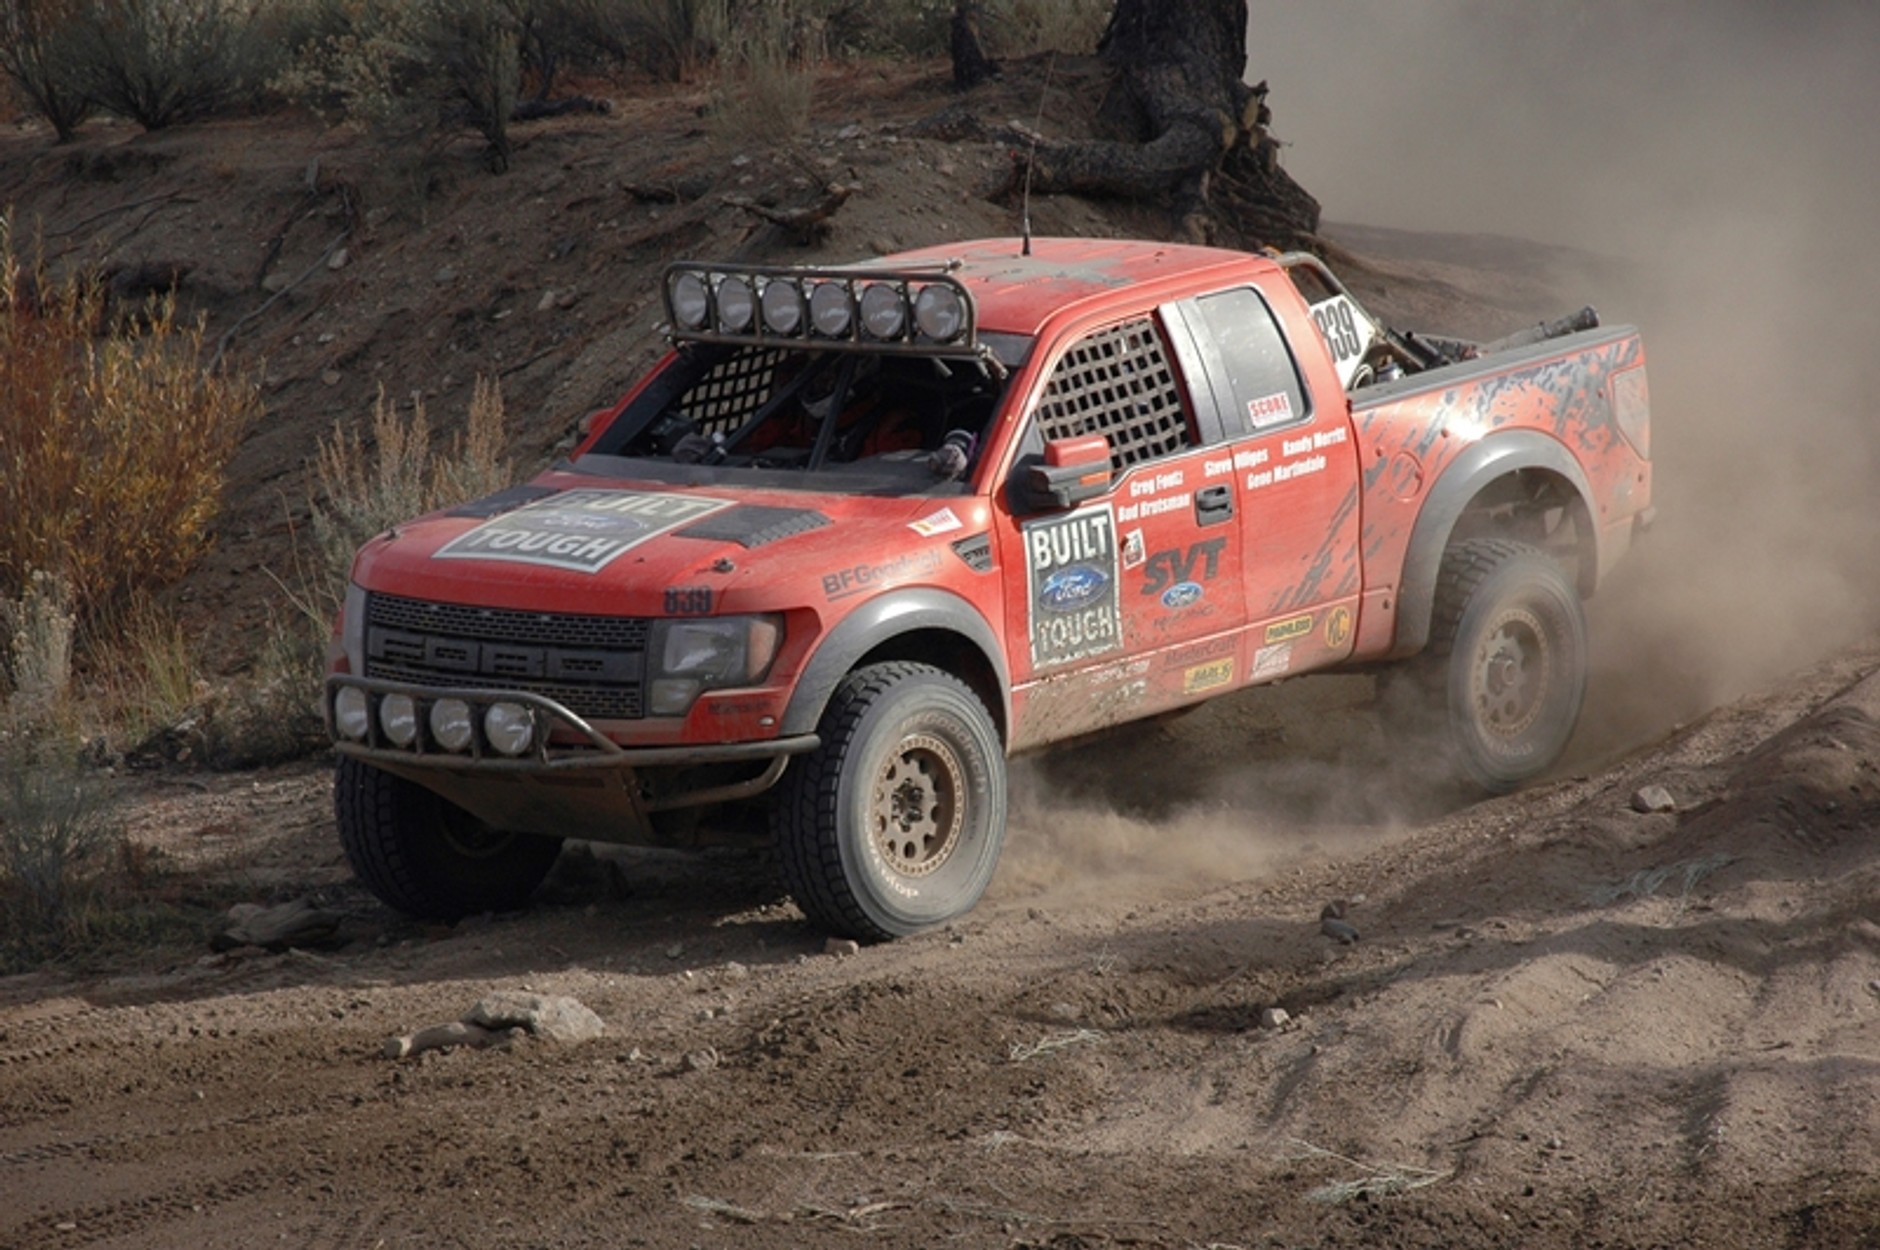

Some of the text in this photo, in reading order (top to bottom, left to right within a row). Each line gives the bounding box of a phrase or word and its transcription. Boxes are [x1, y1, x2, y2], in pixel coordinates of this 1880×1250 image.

[467, 528, 622, 560] TOUGH
[1031, 514, 1109, 571] BUILT
[1140, 536, 1228, 596] SVT
[821, 550, 944, 596] BFGoodrich
[1036, 605, 1114, 652] TOUGH
